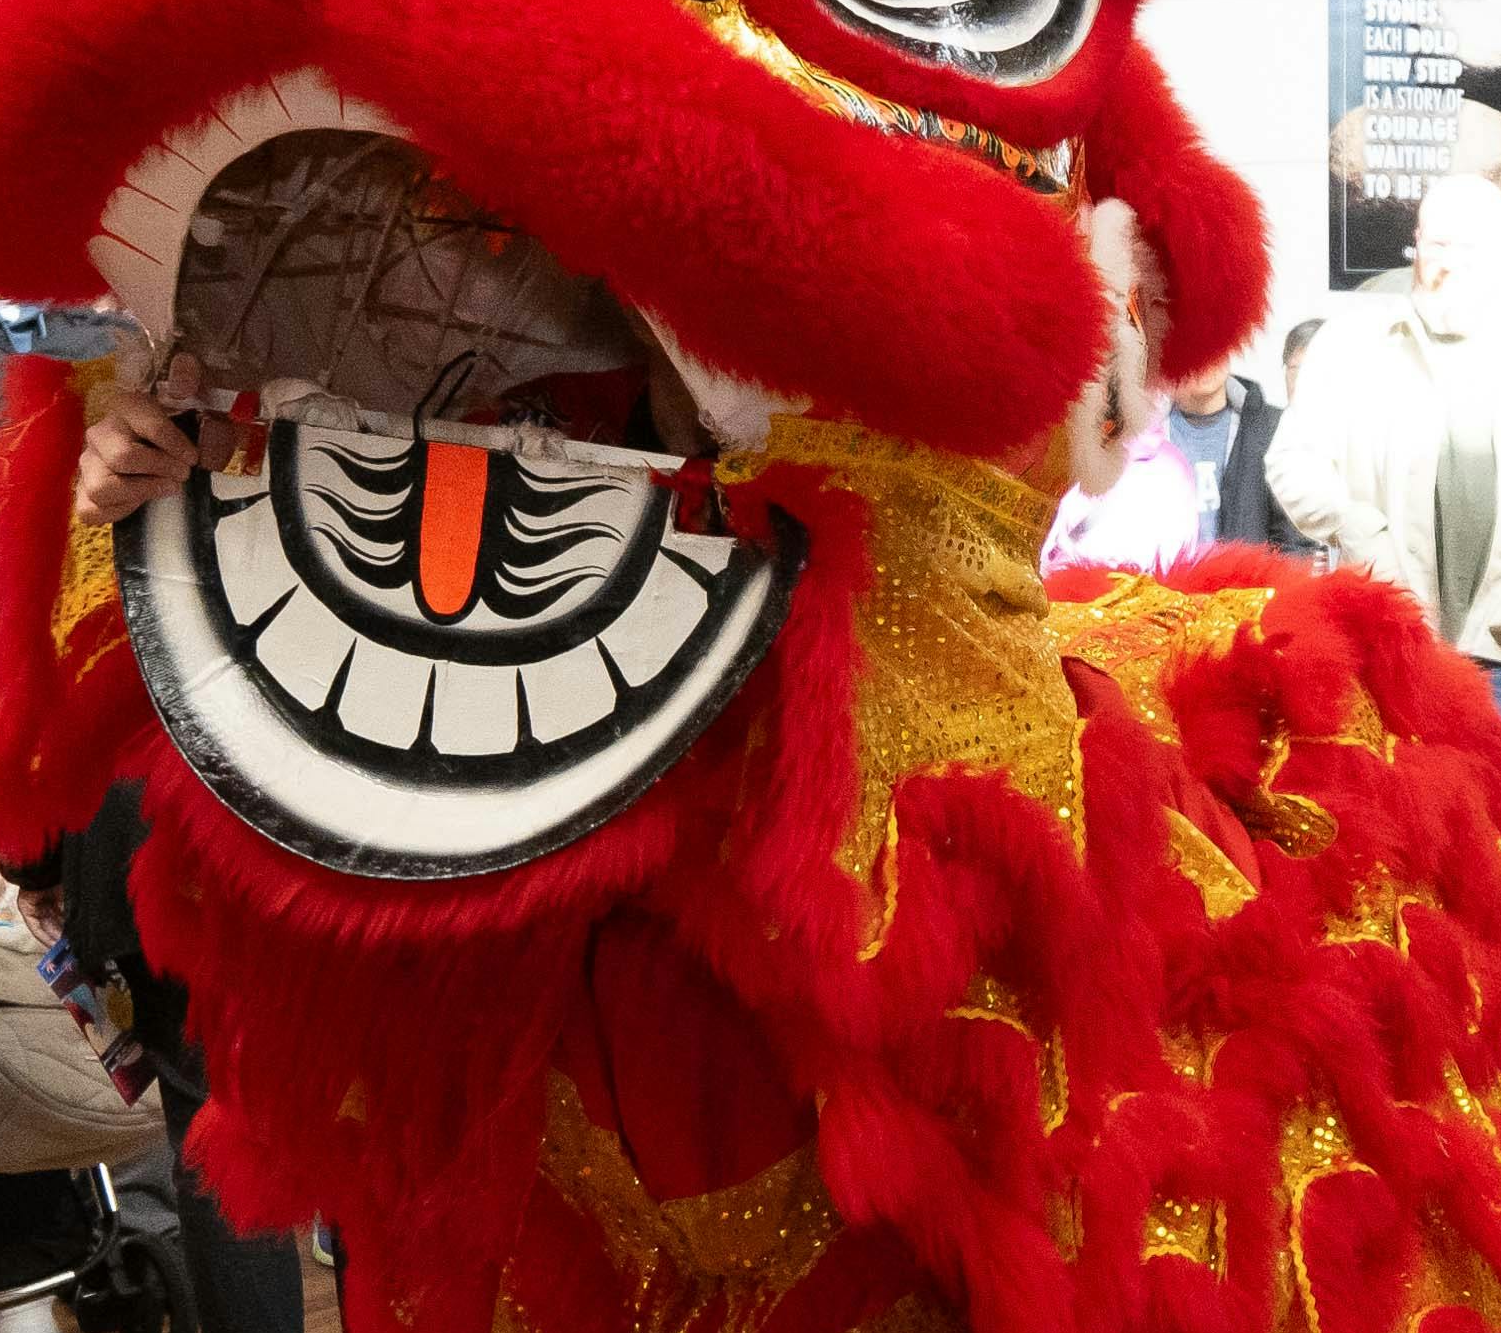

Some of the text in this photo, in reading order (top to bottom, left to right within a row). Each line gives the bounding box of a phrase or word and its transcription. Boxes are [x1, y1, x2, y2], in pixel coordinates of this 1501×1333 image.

[1364, 27, 1403, 52] EACH
[1364, 56, 1463, 84] NEW STEP
[1365, 86, 1465, 113] IS A STORY OF
[1365, 115, 1459, 141] COURAGE
[1365, 145, 1452, 169] WAITING
[1364, 173, 1392, 199] TO
[1395, 175, 1422, 200] BE
